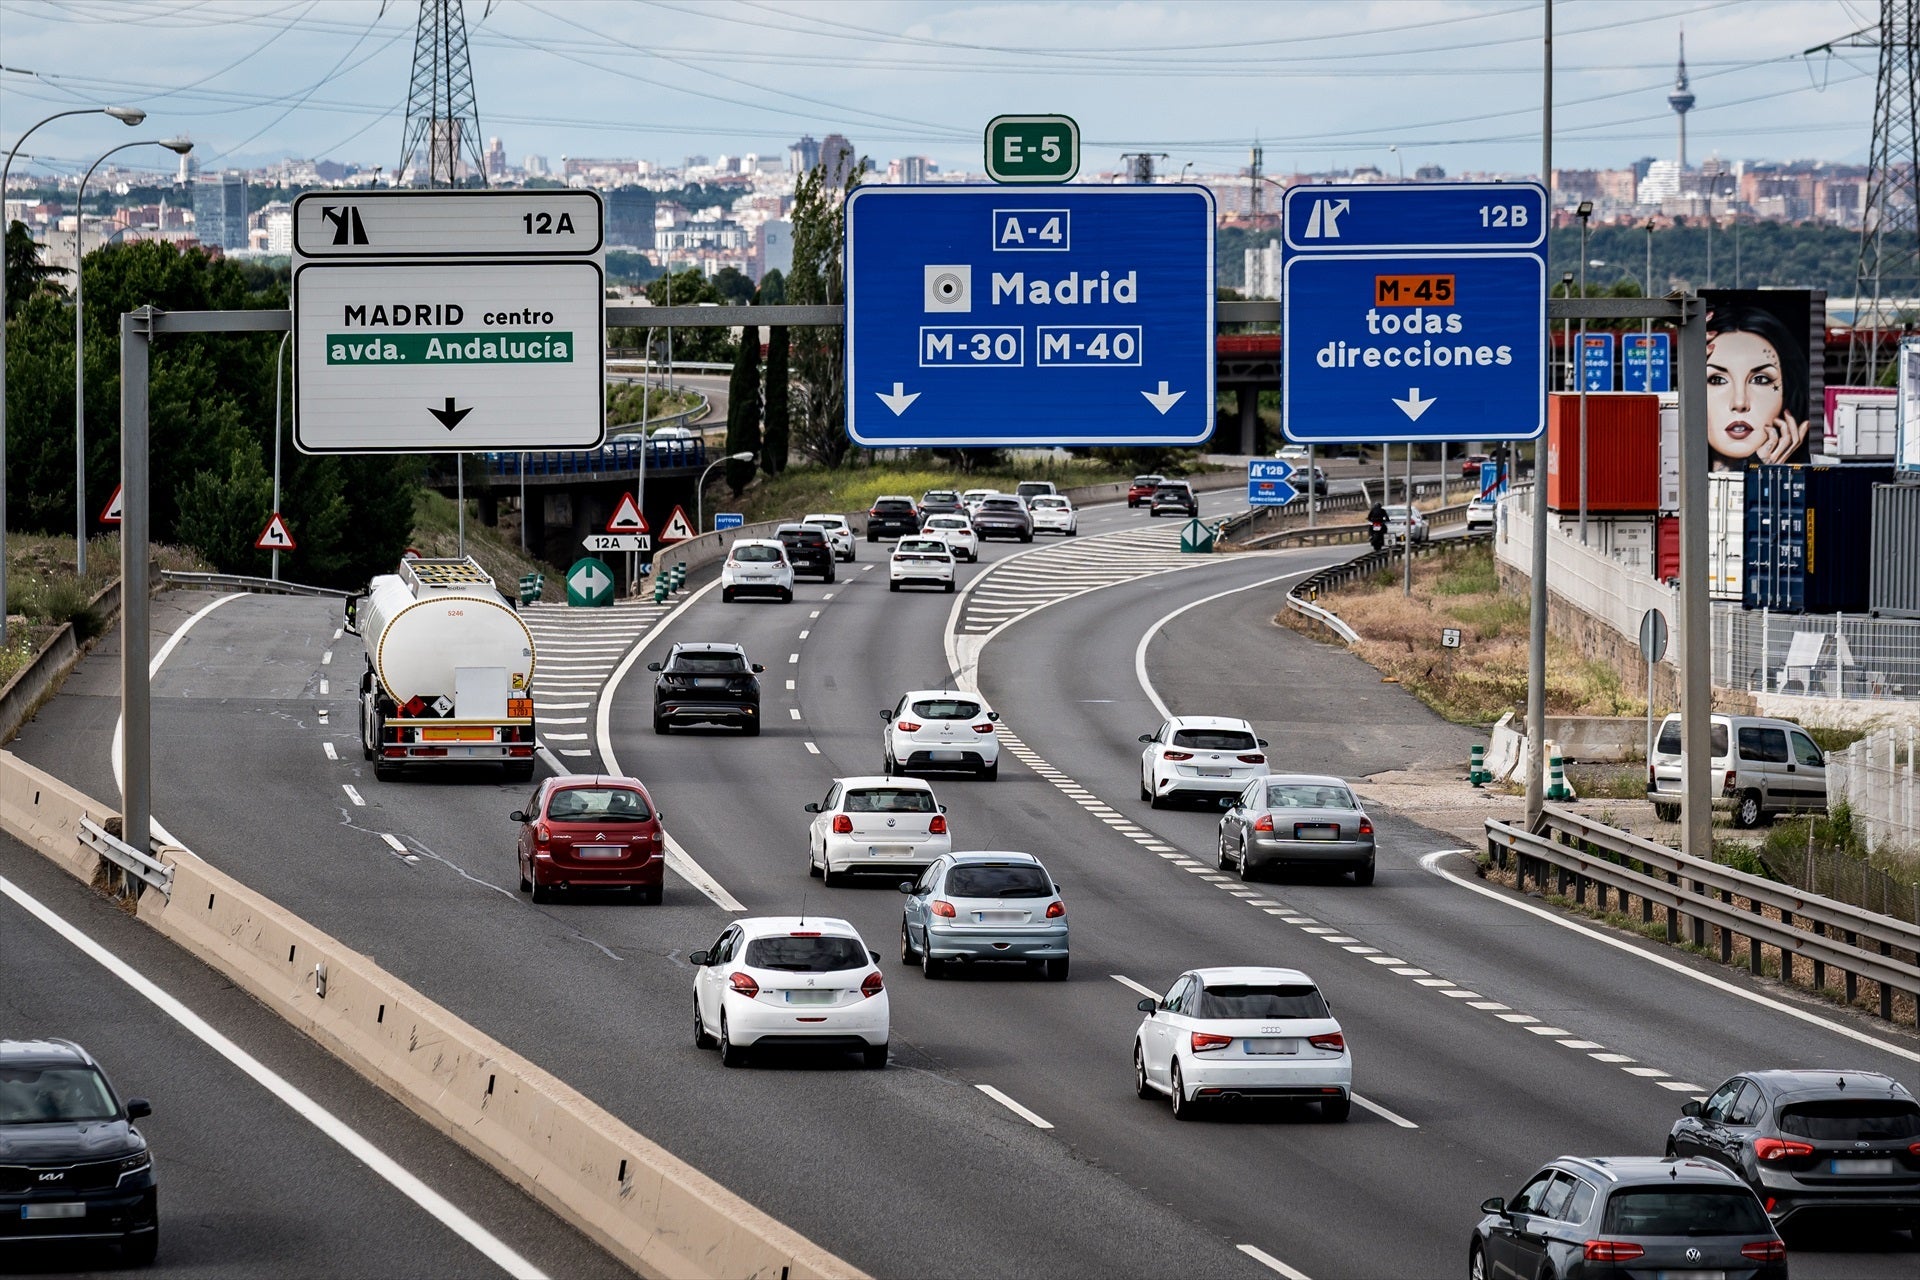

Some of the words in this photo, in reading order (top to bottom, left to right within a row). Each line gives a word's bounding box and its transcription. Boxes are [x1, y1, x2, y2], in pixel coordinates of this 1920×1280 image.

[1004, 136, 1061, 163] E-5
[523, 212, 575, 235] 12A
[1479, 205, 1528, 228] 12B
[1001, 217, 1063, 244] A-4
[991, 270, 1137, 305] Madrid
[1379, 278, 1452, 302] M-45
[344, 304, 465, 327] MADRID
[482, 307, 555, 325] centro
[1365, 307, 1463, 335] todas
[331, 338, 406, 361] avda.
[425, 336, 569, 361] Andalucía
[926, 333, 1017, 361] M-30
[1044, 332, 1135, 360] M-40
[1316, 339, 1513, 368] direcciones
[595, 537, 620, 549] 12A
[1447, 637, 1455, 645] 9
[516, 700, 525, 708] 33
